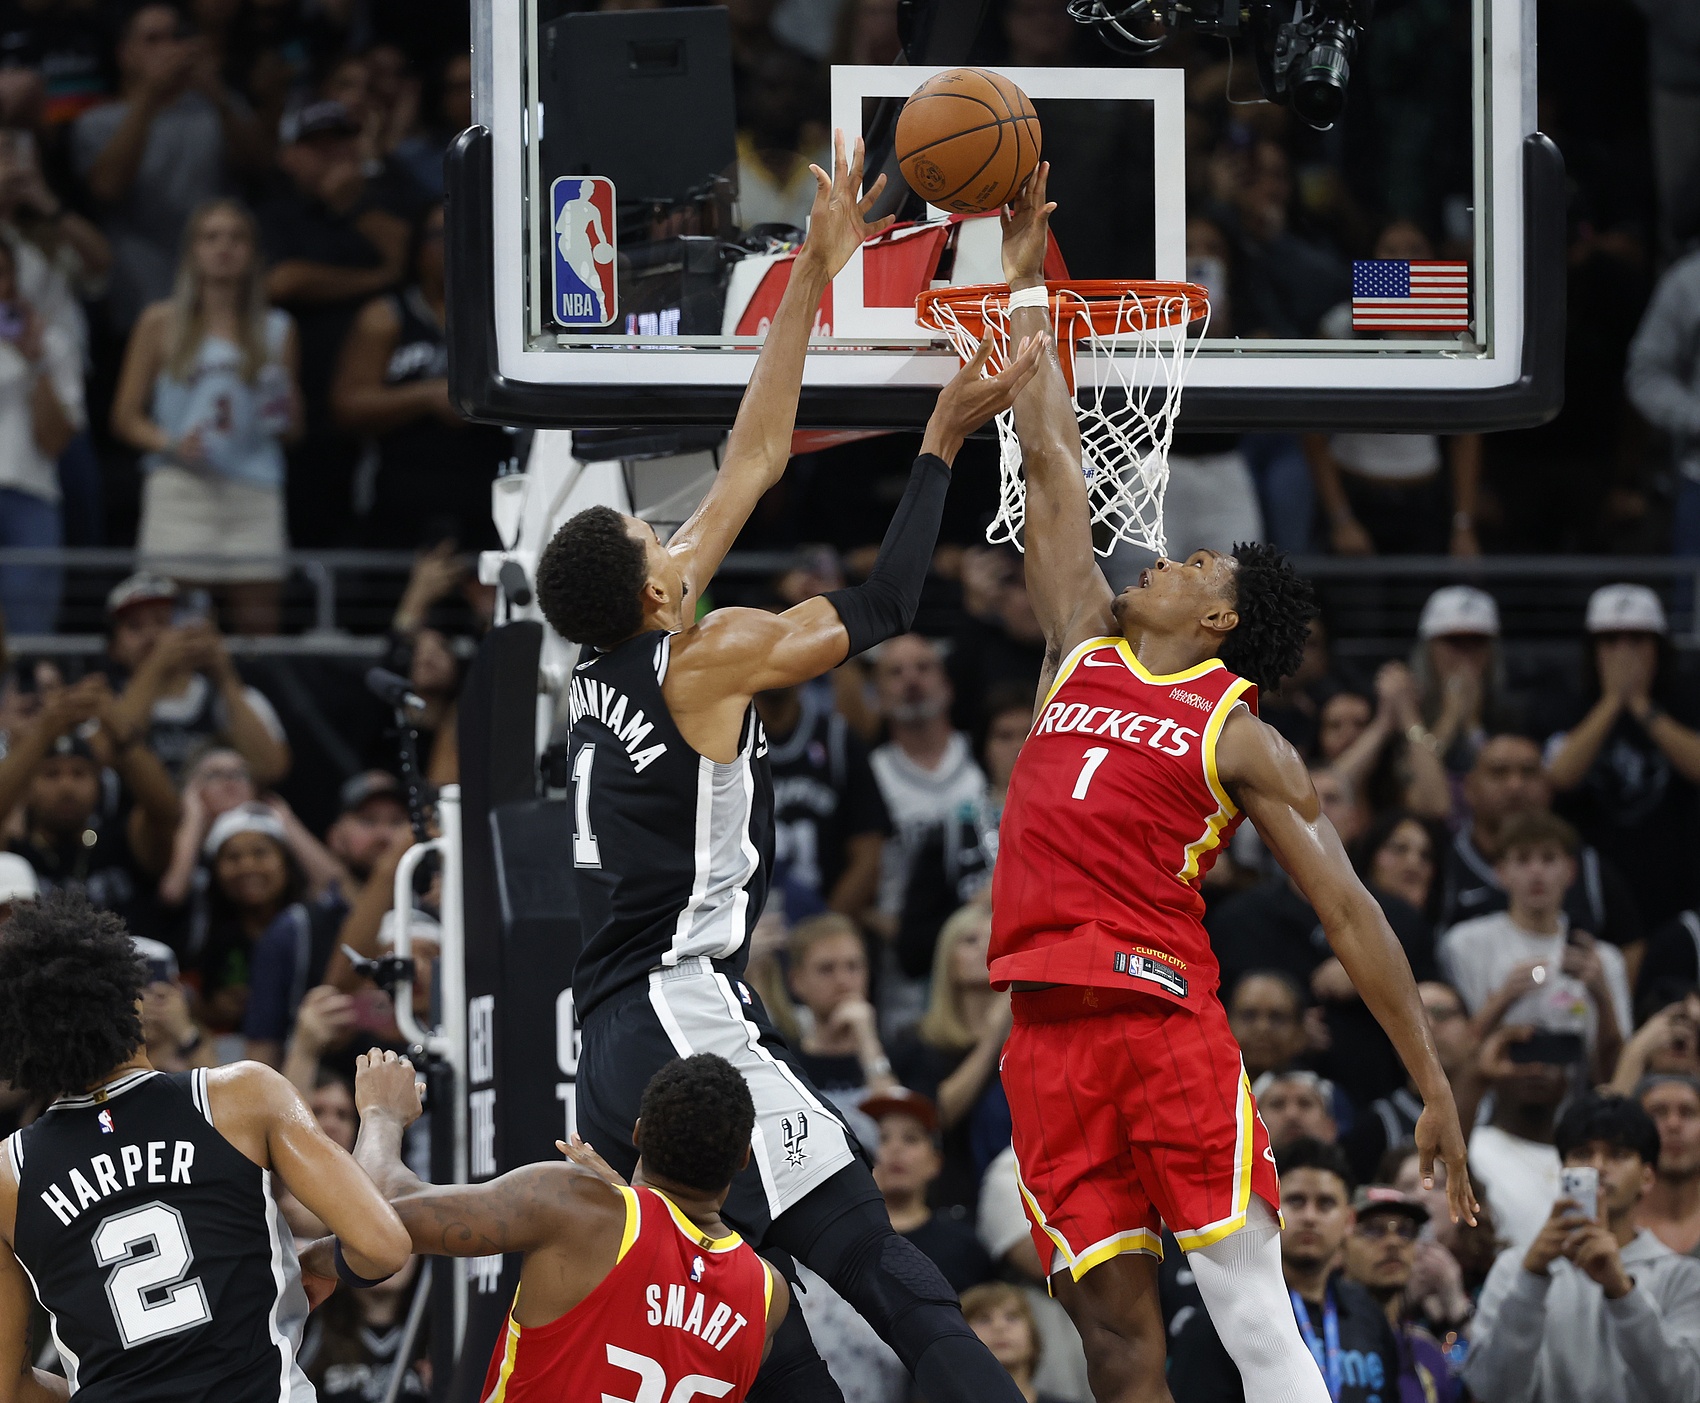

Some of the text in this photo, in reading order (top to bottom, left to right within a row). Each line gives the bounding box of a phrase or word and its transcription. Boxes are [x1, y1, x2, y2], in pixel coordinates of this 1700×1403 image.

[562, 293, 594, 316] NBA
[1168, 692, 1210, 713] HERMANN
[1170, 687, 1213, 709] MEMORIAL
[1071, 746, 1110, 801] 1
[571, 742, 603, 870] 1
[1136, 946, 1167, 961] CLUTCH
[40, 1140, 195, 1227] HARPER
[90, 1199, 213, 1351] 2
[645, 1283, 748, 1352] SMART
